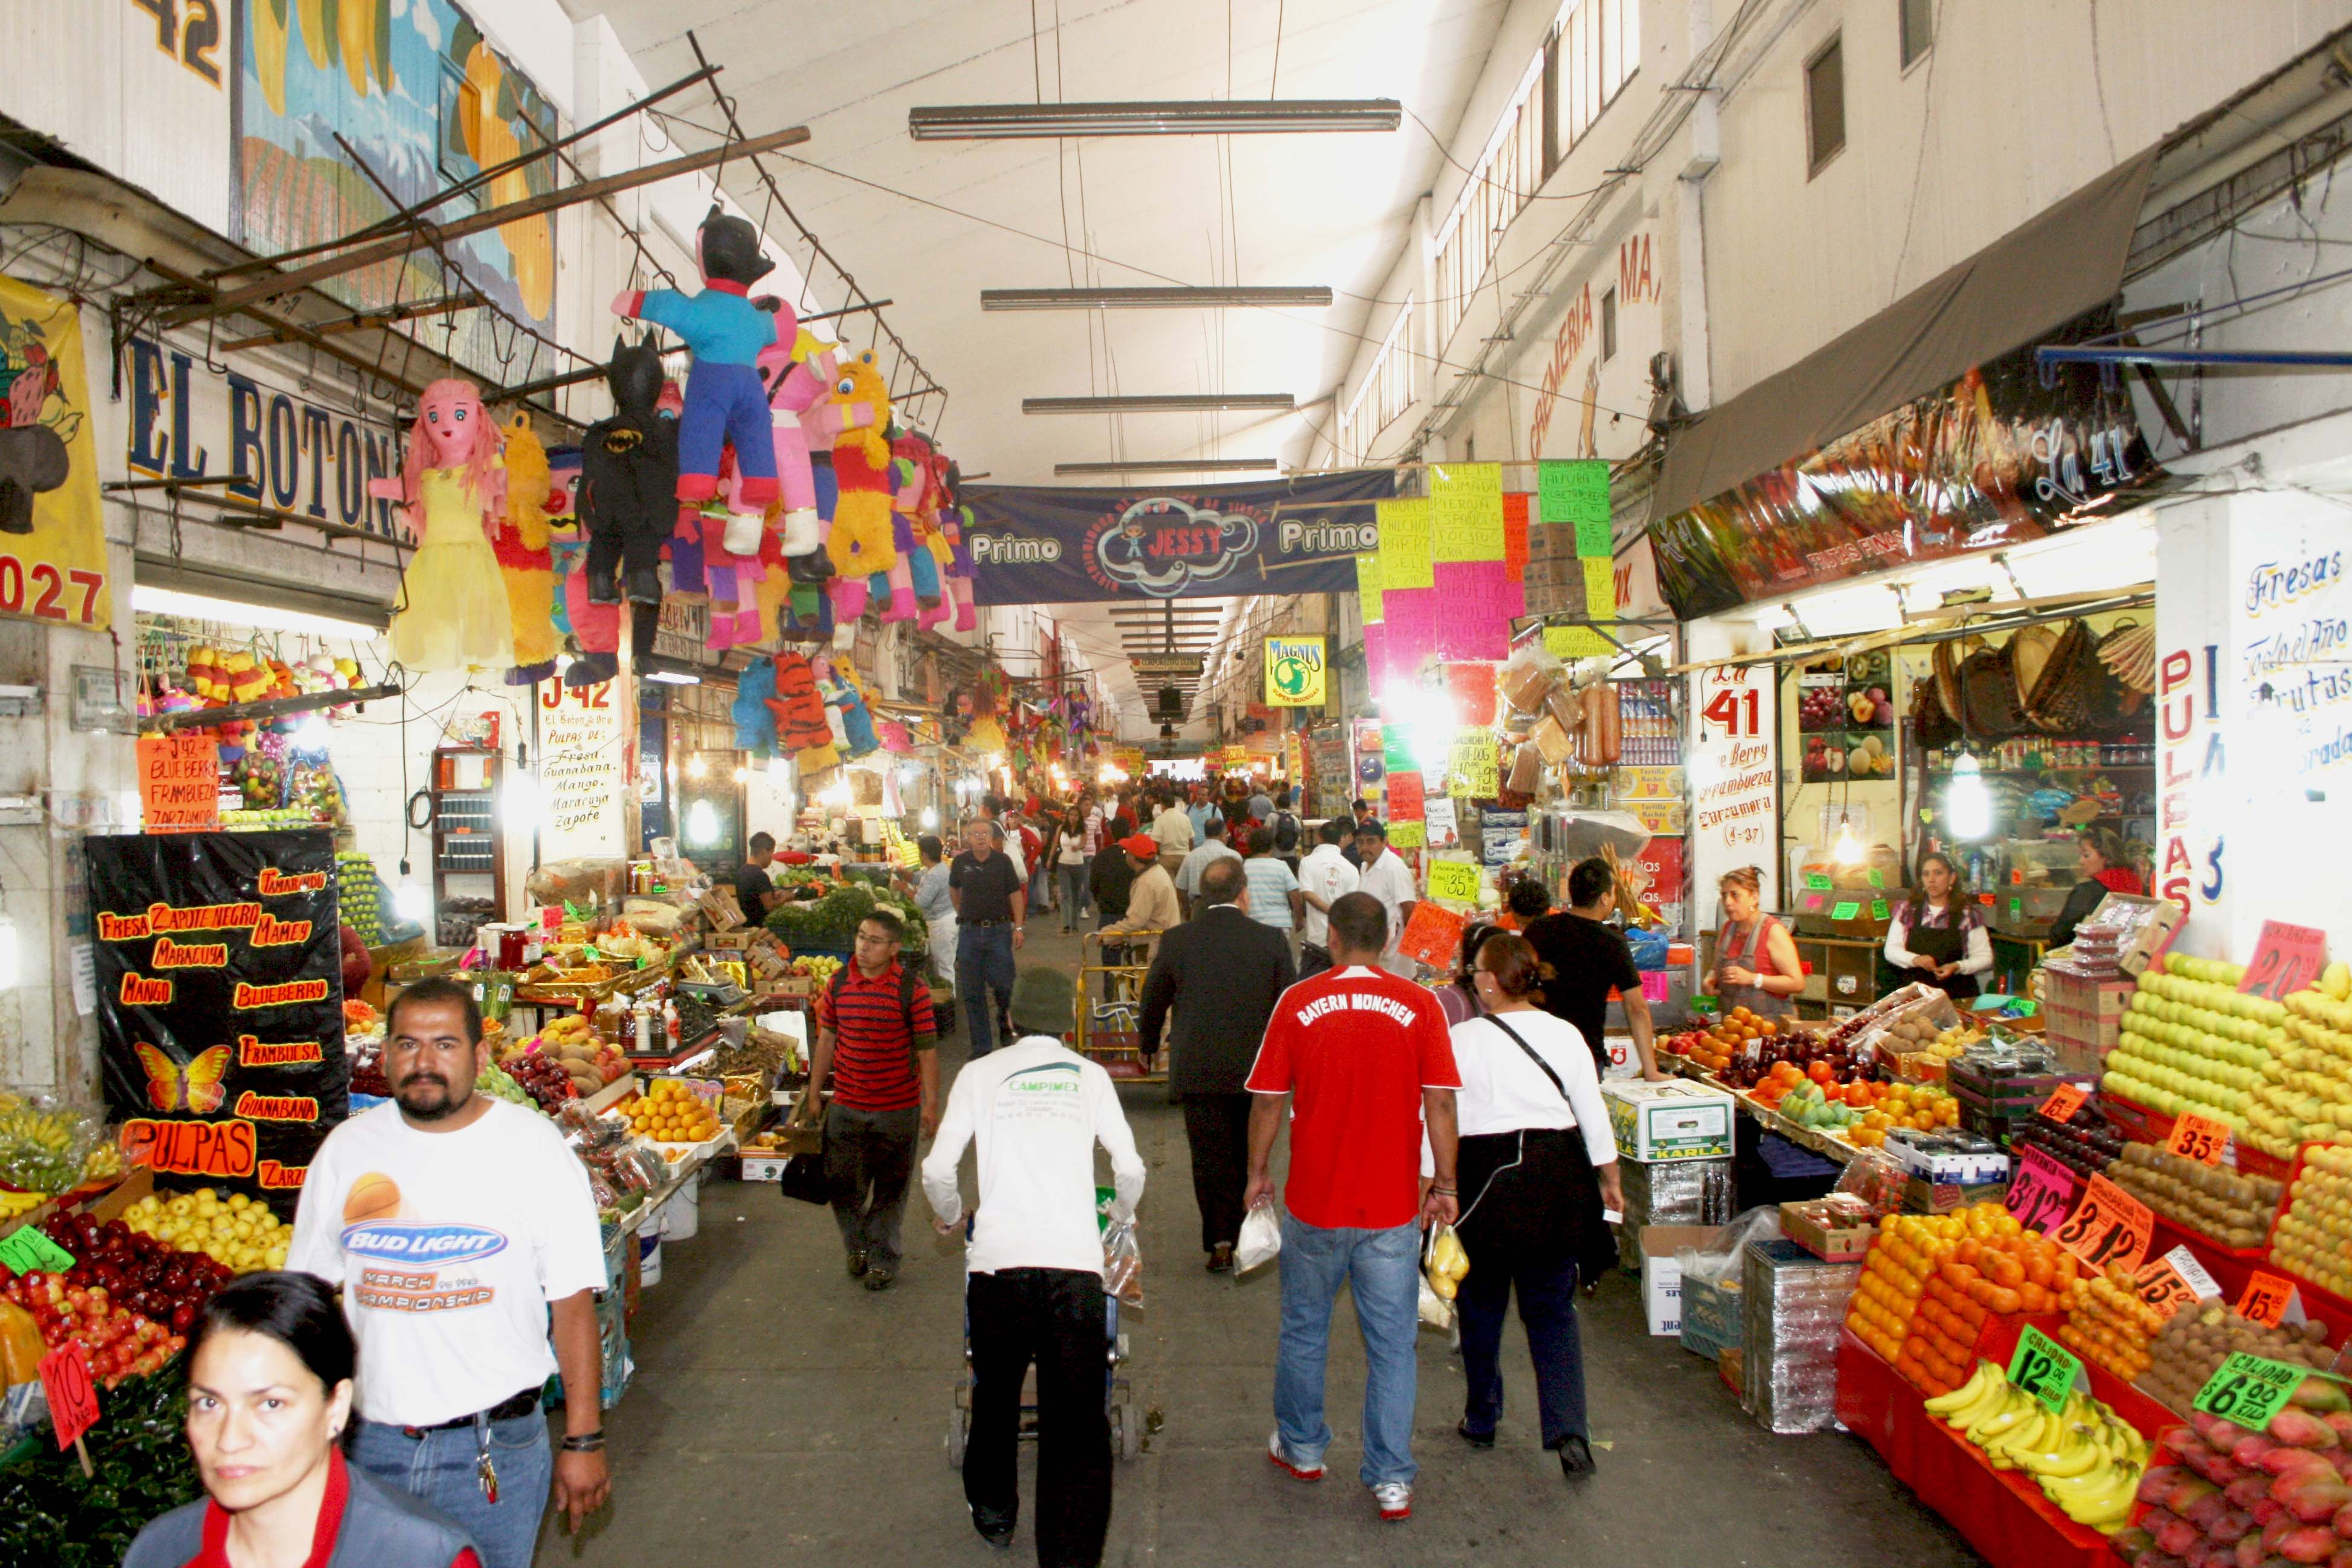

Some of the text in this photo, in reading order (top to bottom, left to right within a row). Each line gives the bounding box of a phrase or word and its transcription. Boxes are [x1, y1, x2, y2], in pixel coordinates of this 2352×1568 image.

[128, 337, 392, 538] EL BOTON
[2031, 417, 2133, 506] La 41
[970, 534, 1060, 564] Primo
[1148, 528, 1223, 557] JESSY
[1279, 519, 1378, 551] Primo
[2246, 551, 2341, 610] Fresas
[1270, 641, 1321, 673] MAGNUS
[1701, 688, 1760, 738] 41
[548, 730, 581, 745] PULPAS
[1730, 742, 1768, 769] Berry
[1448, 875, 1466, 896] 35
[100, 913, 149, 938] FRESA
[152, 905, 259, 930] ZAPOTE NEGRO
[253, 916, 310, 945] MAMEY
[155, 940, 227, 966] MARACUYA
[124, 976, 171, 1003] MANGO
[237, 981, 325, 1007] BLUEBERRY
[1297, 994, 1348, 1026] BAYERN
[242, 1037, 320, 1065] FRAMBUESA
[1009, 1081, 1080, 1093] CAMPIMEX
[239, 1093, 315, 1120] GUANABANA
[134, 1122, 253, 1175] PULPAS
[1656, 1146, 1723, 1159] KARLA
[2178, 1131, 2212, 1160] 35
[261, 1161, 309, 1187] ZARZ
[2059, 1201, 2099, 1244] 3
[348, 1232, 497, 1253] BUD LIGHT
[365, 1272, 432, 1289] MARCH
[2242, 1289, 2272, 1320] 15
[2016, 1347, 2051, 1396] 12
